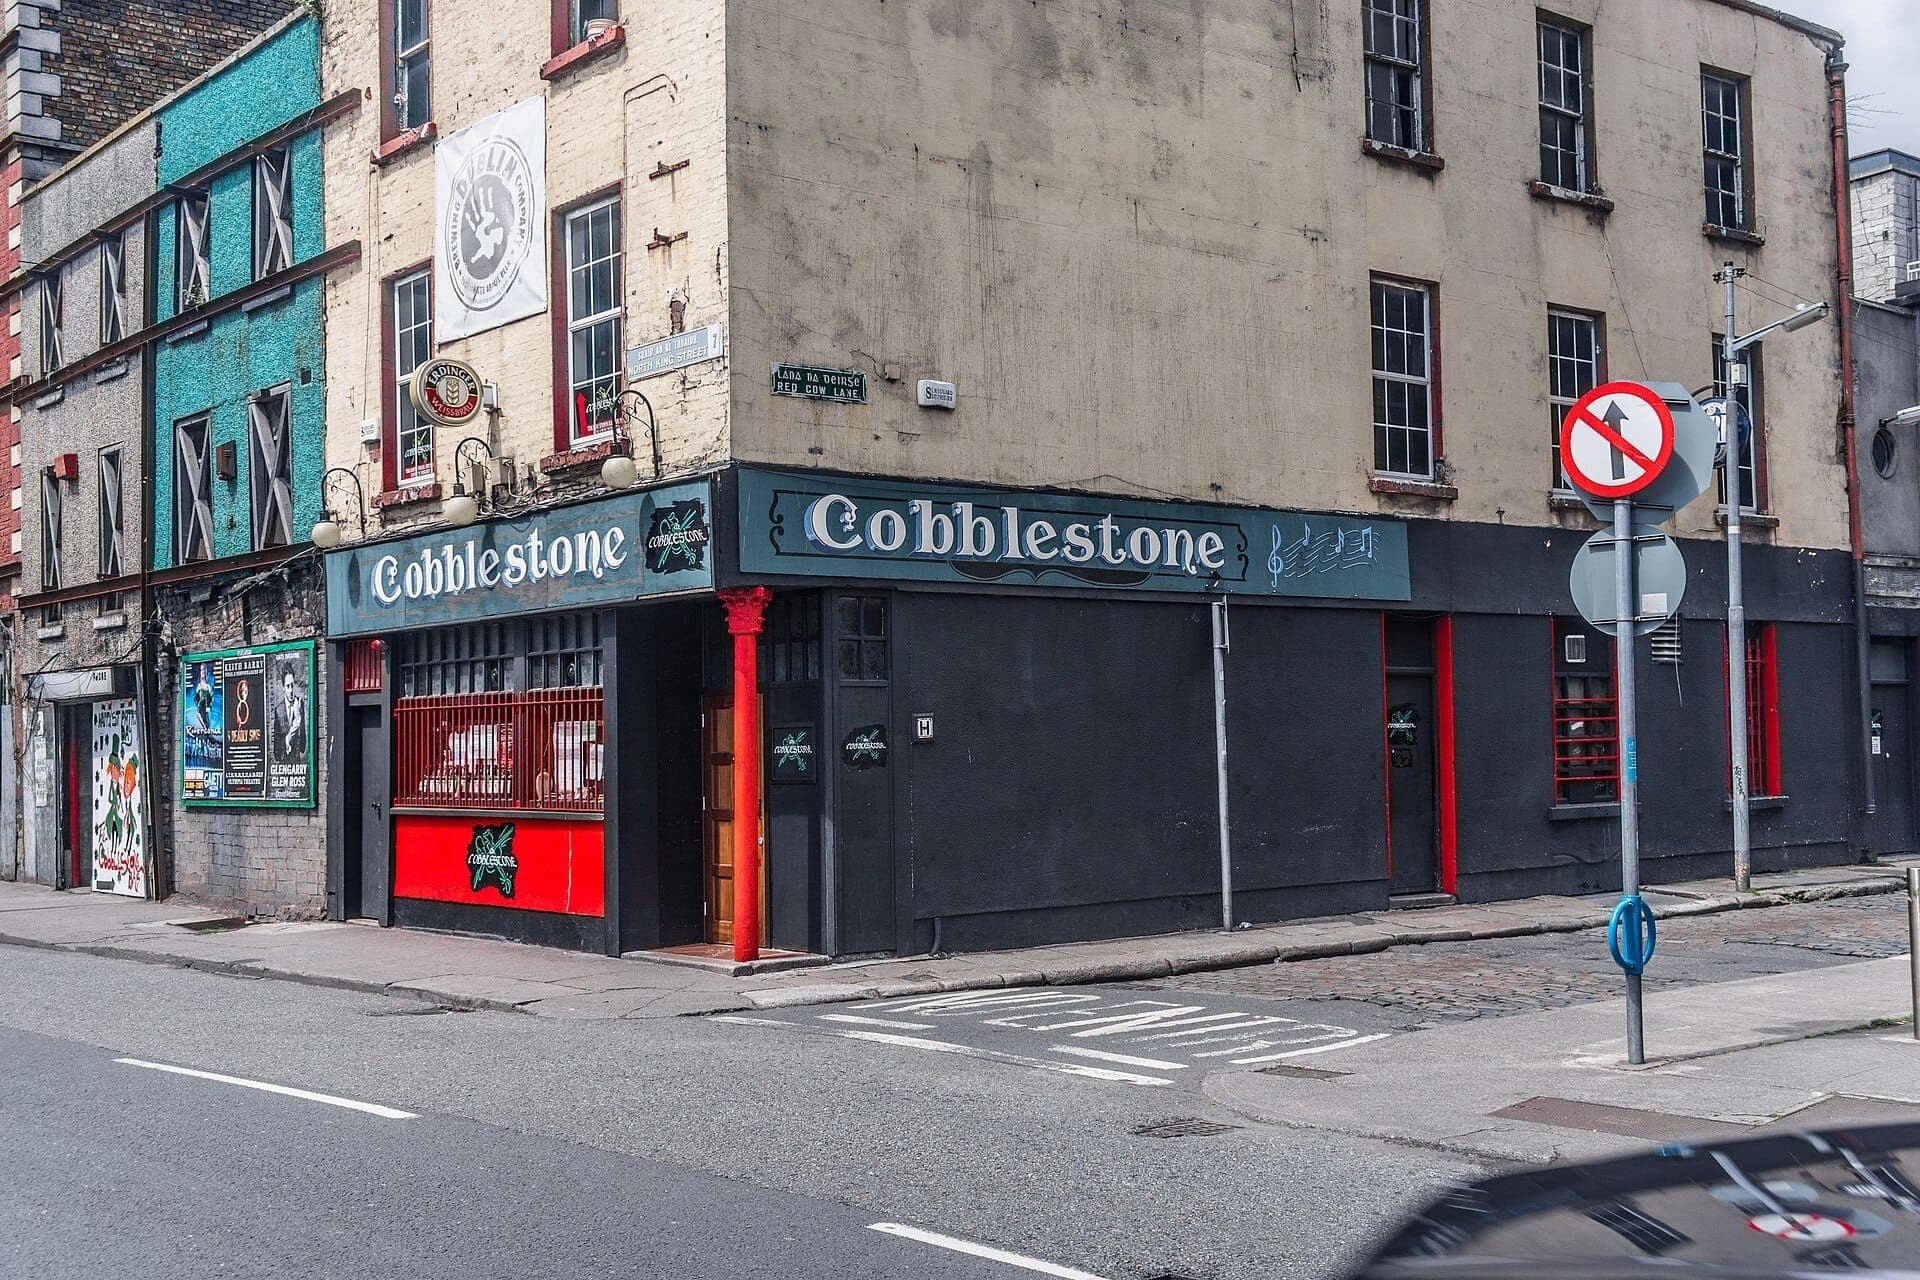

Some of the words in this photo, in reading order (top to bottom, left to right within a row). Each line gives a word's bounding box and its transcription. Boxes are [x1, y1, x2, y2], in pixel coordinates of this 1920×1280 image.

[450, 202, 461, 272] BREWING
[456, 147, 518, 200] DUBLIN
[712, 334, 718, 349] 7
[629, 362, 653, 376] NORTH
[656, 355, 674, 368] KING
[678, 345, 708, 362] STREET
[428, 366, 476, 391] ERDINGER
[777, 382, 798, 392] RED
[806, 384, 826, 395] COW
[648, 529, 707, 548] COBBLESTONE
[804, 494, 1226, 576] Cobblestone
[372, 526, 628, 604] Cobblestone
[920, 721, 930, 735] H
[271, 764, 307, 775] GLENGARRY
[272, 776, 288, 787] GLEN
[290, 776, 306, 787] ROSS
